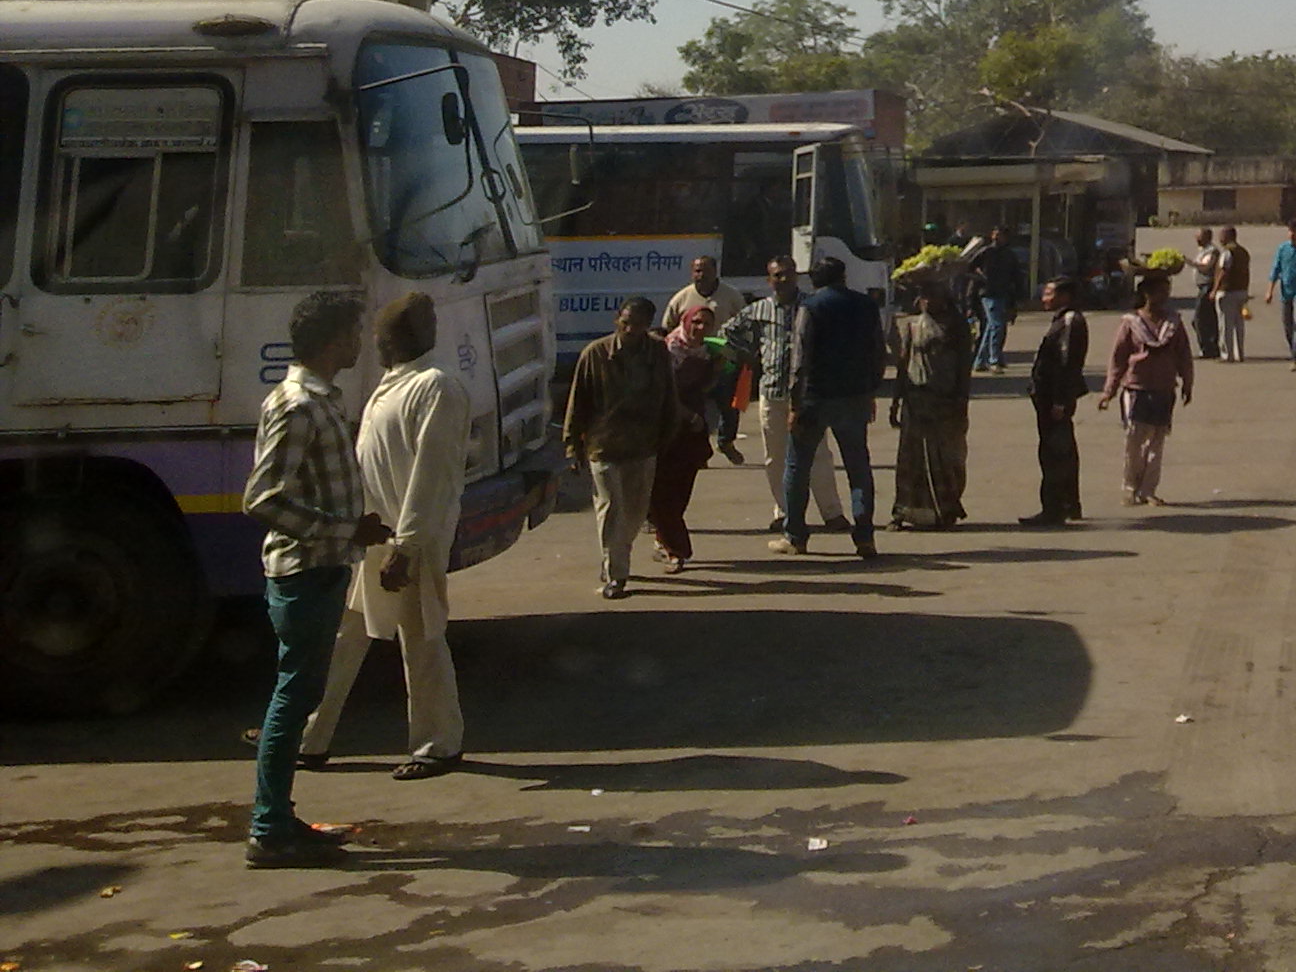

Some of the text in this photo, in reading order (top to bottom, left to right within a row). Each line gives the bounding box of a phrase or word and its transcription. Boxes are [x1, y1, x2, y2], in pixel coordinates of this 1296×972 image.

[588, 252, 641, 272] परिवहन
[647, 251, 682, 271] निगम
[560, 296, 623, 311] BLUE LI
